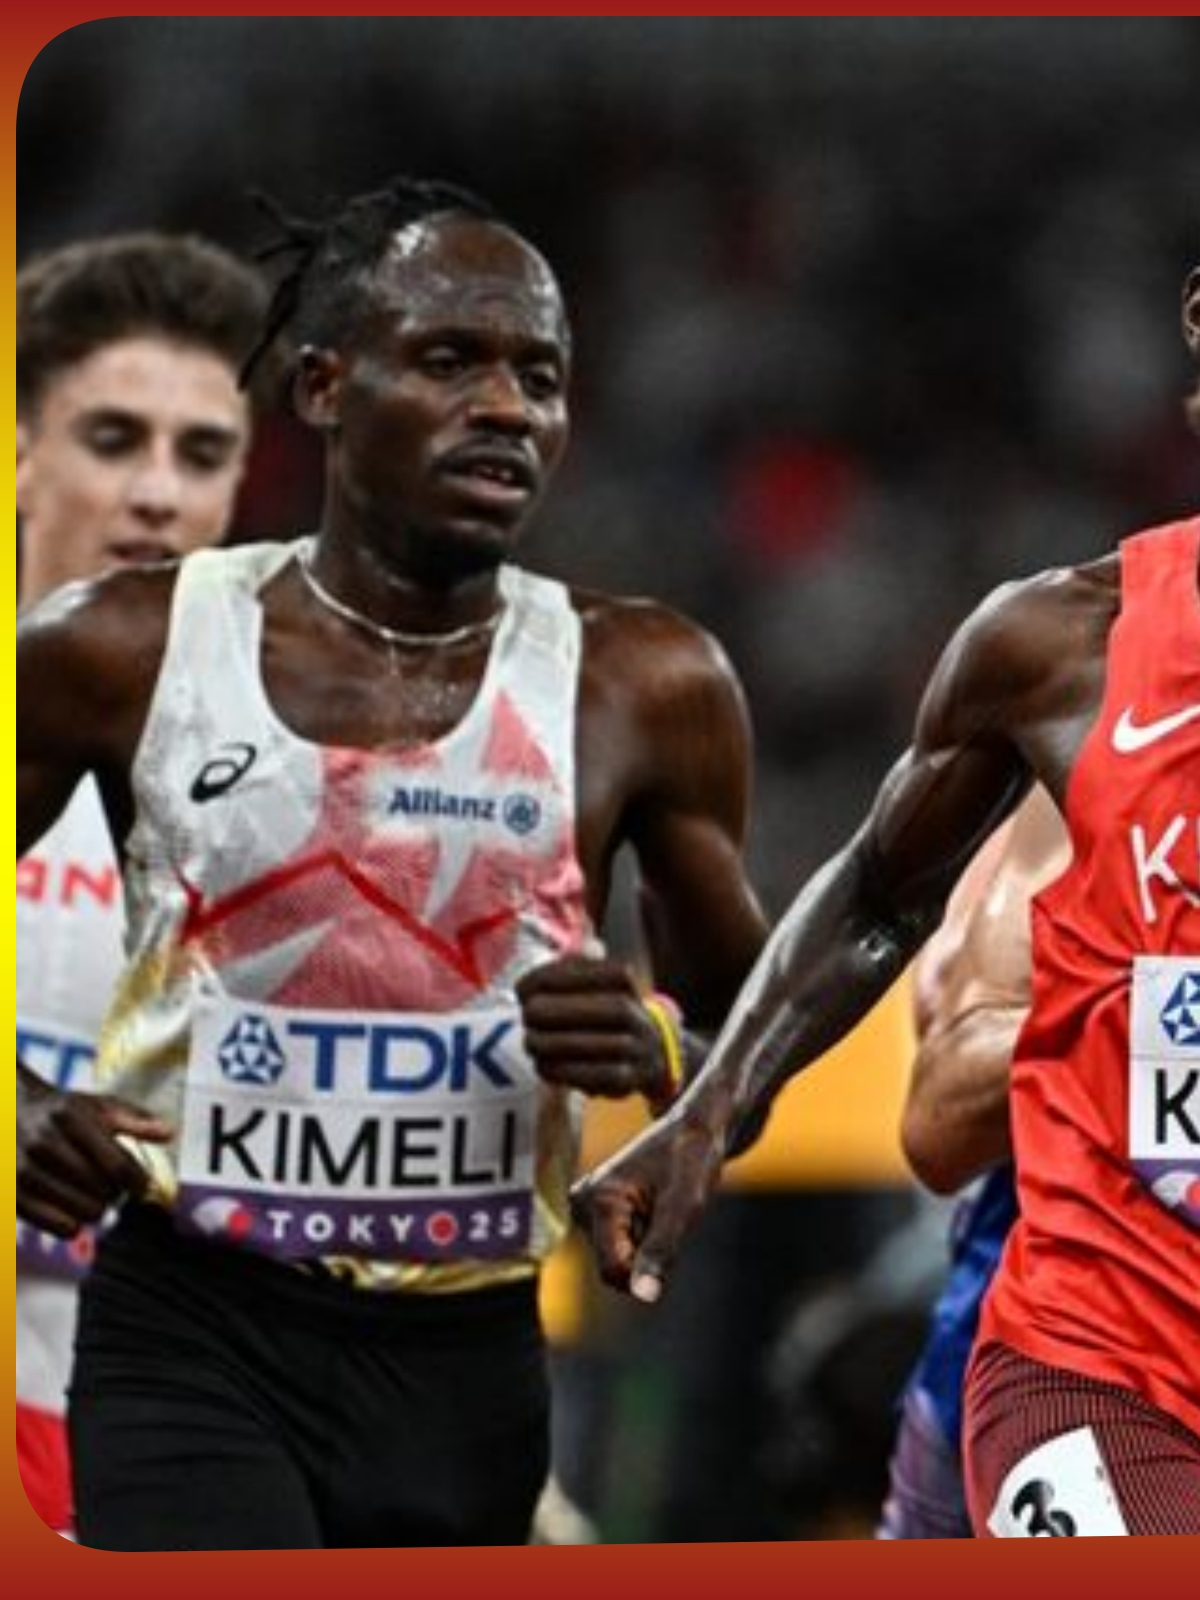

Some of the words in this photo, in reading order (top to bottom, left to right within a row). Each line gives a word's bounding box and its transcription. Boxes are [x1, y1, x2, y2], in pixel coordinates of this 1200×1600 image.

[387, 786, 496, 821] Allianz
[288, 1018, 517, 1092] TDK
[208, 1104, 517, 1187] KIMELI
